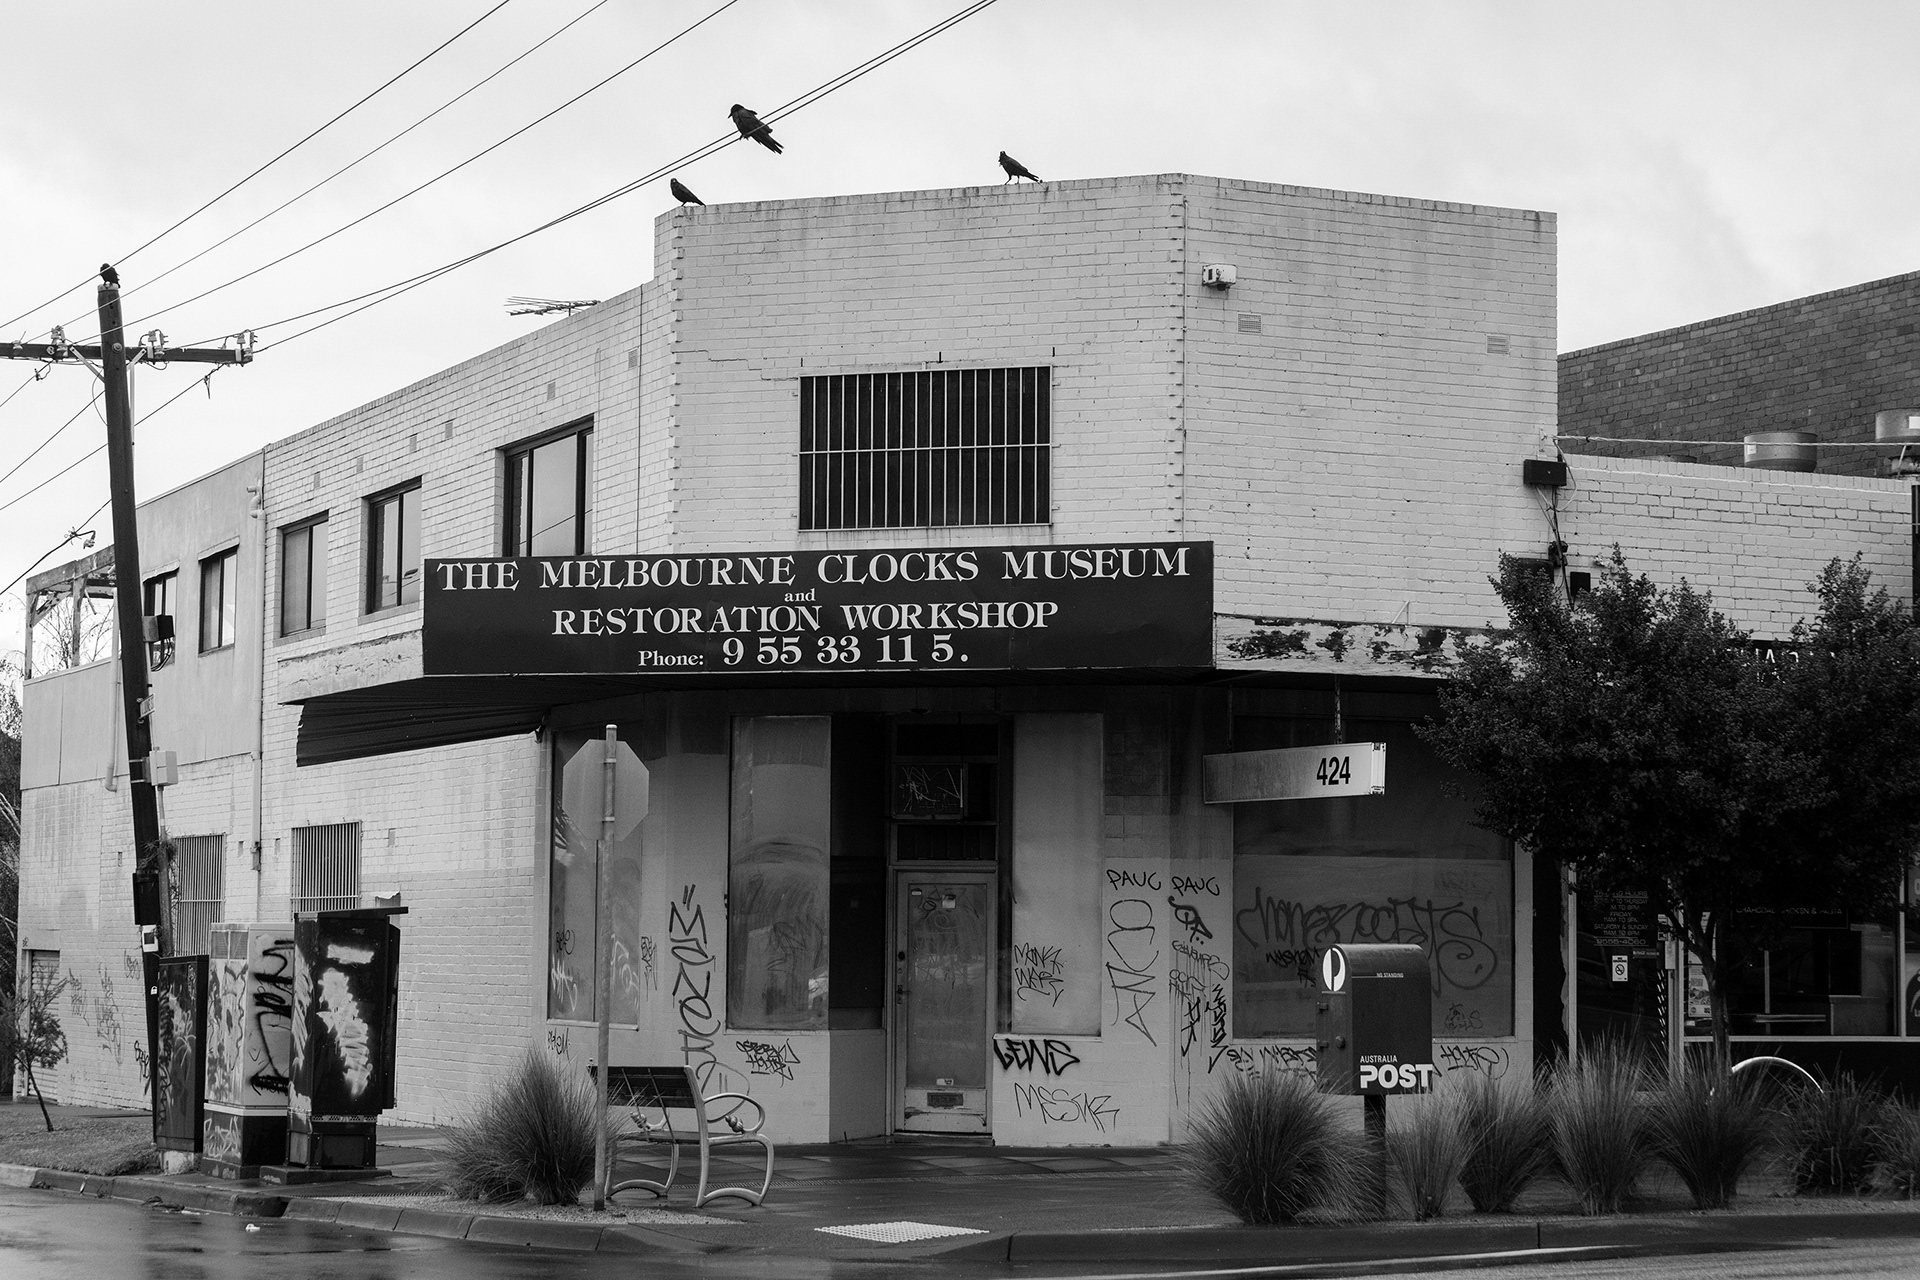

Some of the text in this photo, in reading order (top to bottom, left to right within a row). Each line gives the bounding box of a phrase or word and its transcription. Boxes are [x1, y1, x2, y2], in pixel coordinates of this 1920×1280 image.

[437, 547, 1190, 591] THE MELBOURNE CLOCKS MUSEUM
[784, 588, 816, 602] and
[552, 601, 1059, 636] RESTORATION WORKSHOP
[638, 650, 704, 668] Phone:
[757, 636, 802, 665] 55
[816, 635, 861, 664] 33
[1317, 756, 1351, 786] 424
[1360, 1055, 1398, 1063] AUSTRALIA
[1360, 1063, 1433, 1089] POST
